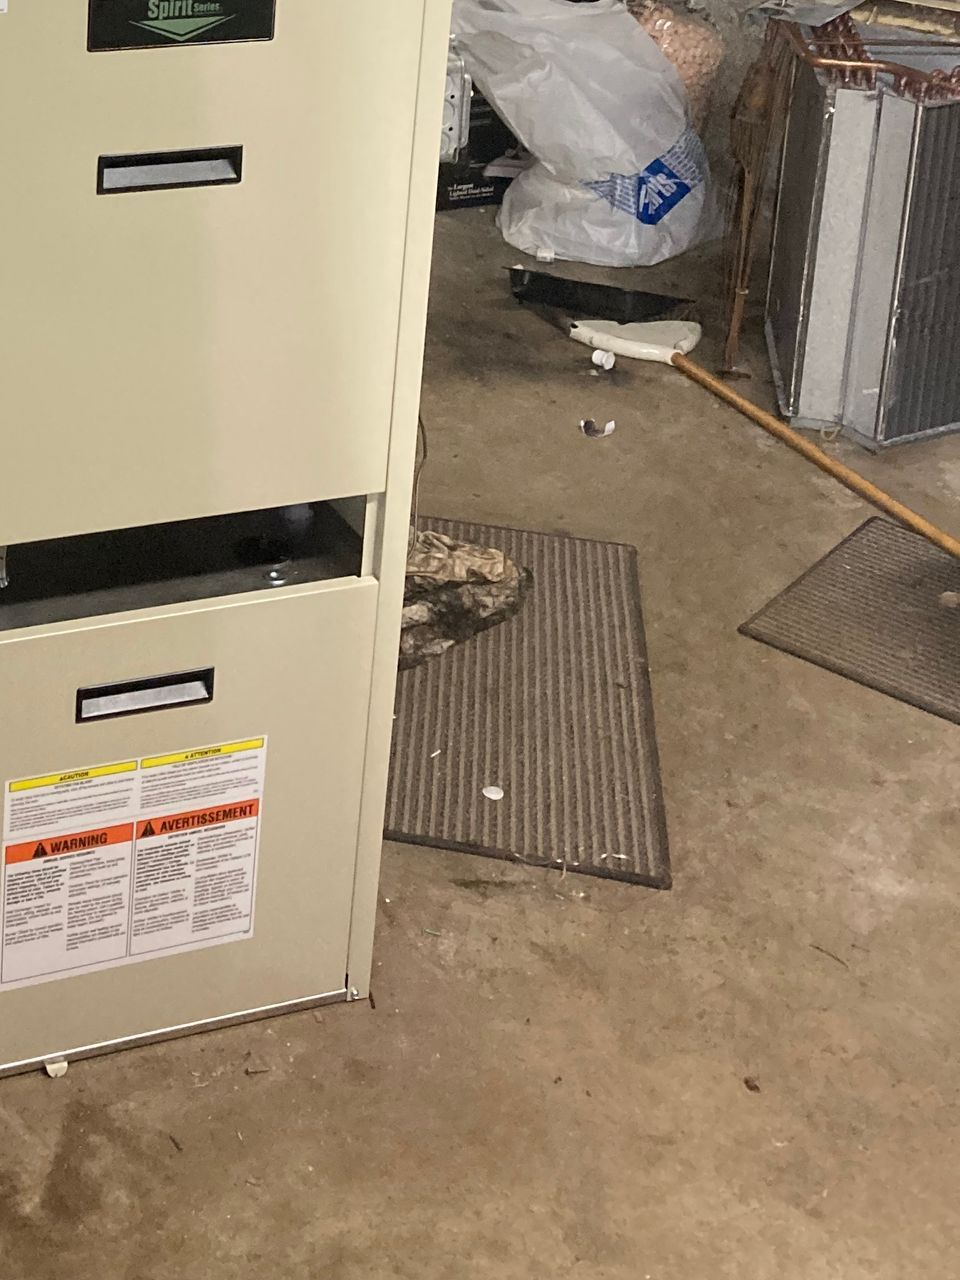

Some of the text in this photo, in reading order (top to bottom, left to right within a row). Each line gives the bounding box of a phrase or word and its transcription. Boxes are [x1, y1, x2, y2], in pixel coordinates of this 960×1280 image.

[189, 748, 221, 759] ATTENTION
[62, 771, 89, 781] CAUTION
[160, 803, 255, 833] AVERTISSEMENT
[50, 832, 108, 853] WARNING
